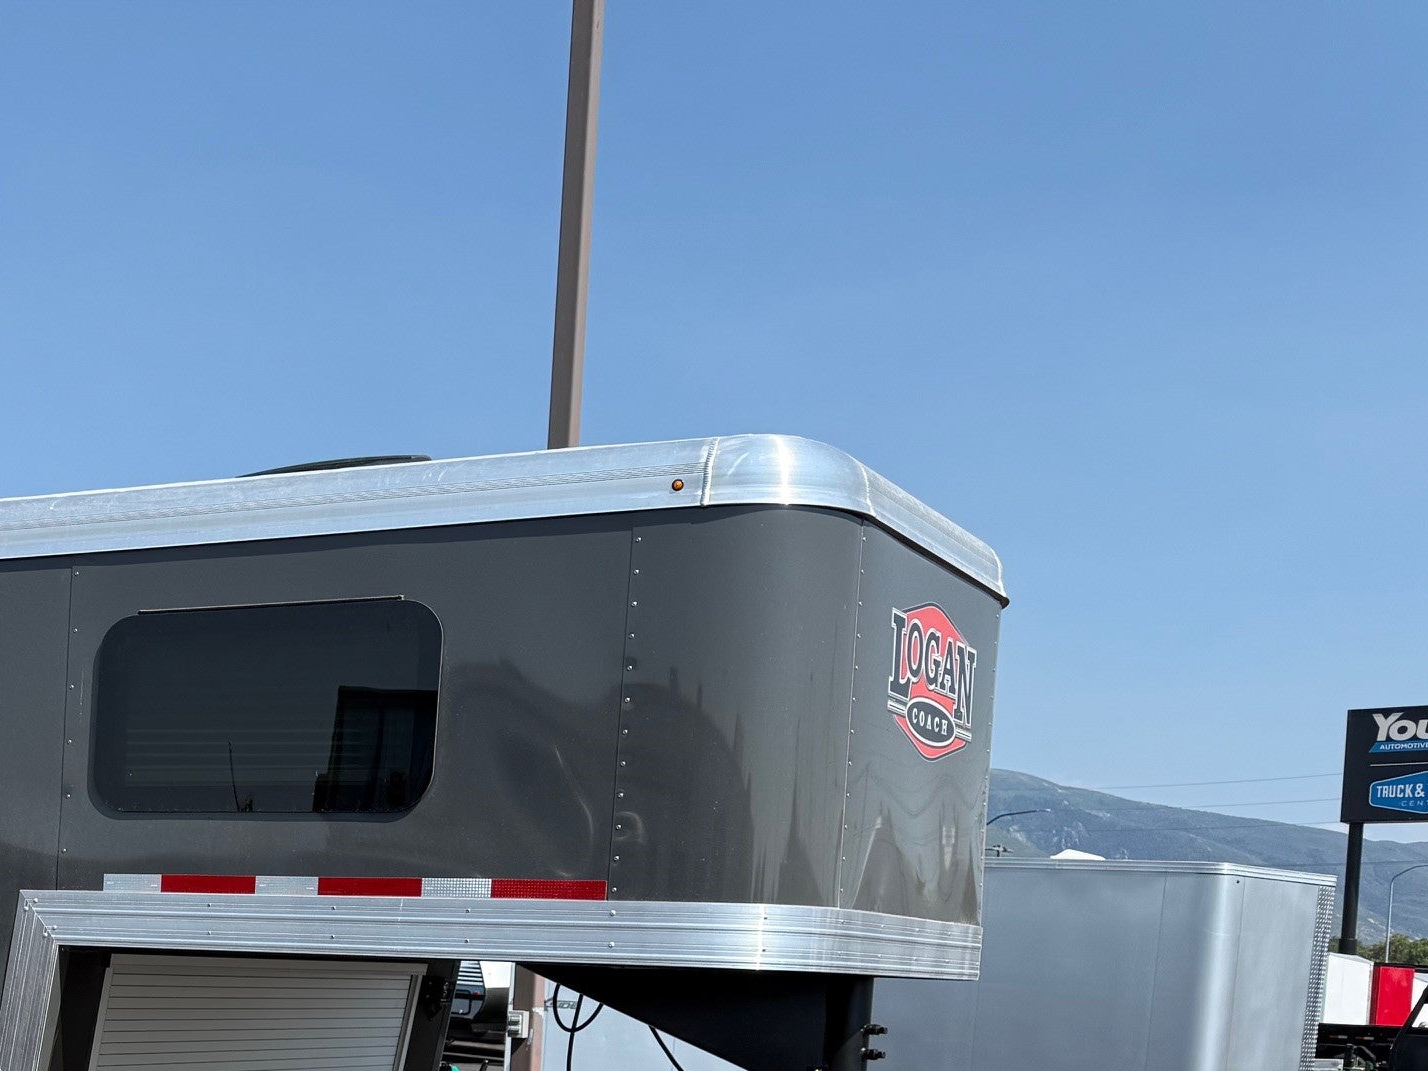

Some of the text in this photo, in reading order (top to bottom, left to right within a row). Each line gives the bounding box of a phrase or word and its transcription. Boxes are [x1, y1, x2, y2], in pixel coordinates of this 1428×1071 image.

[887, 607, 978, 729] LOGAN
[912, 707, 949, 736] COACH
[1377, 783, 1425, 798] TRUCK &
